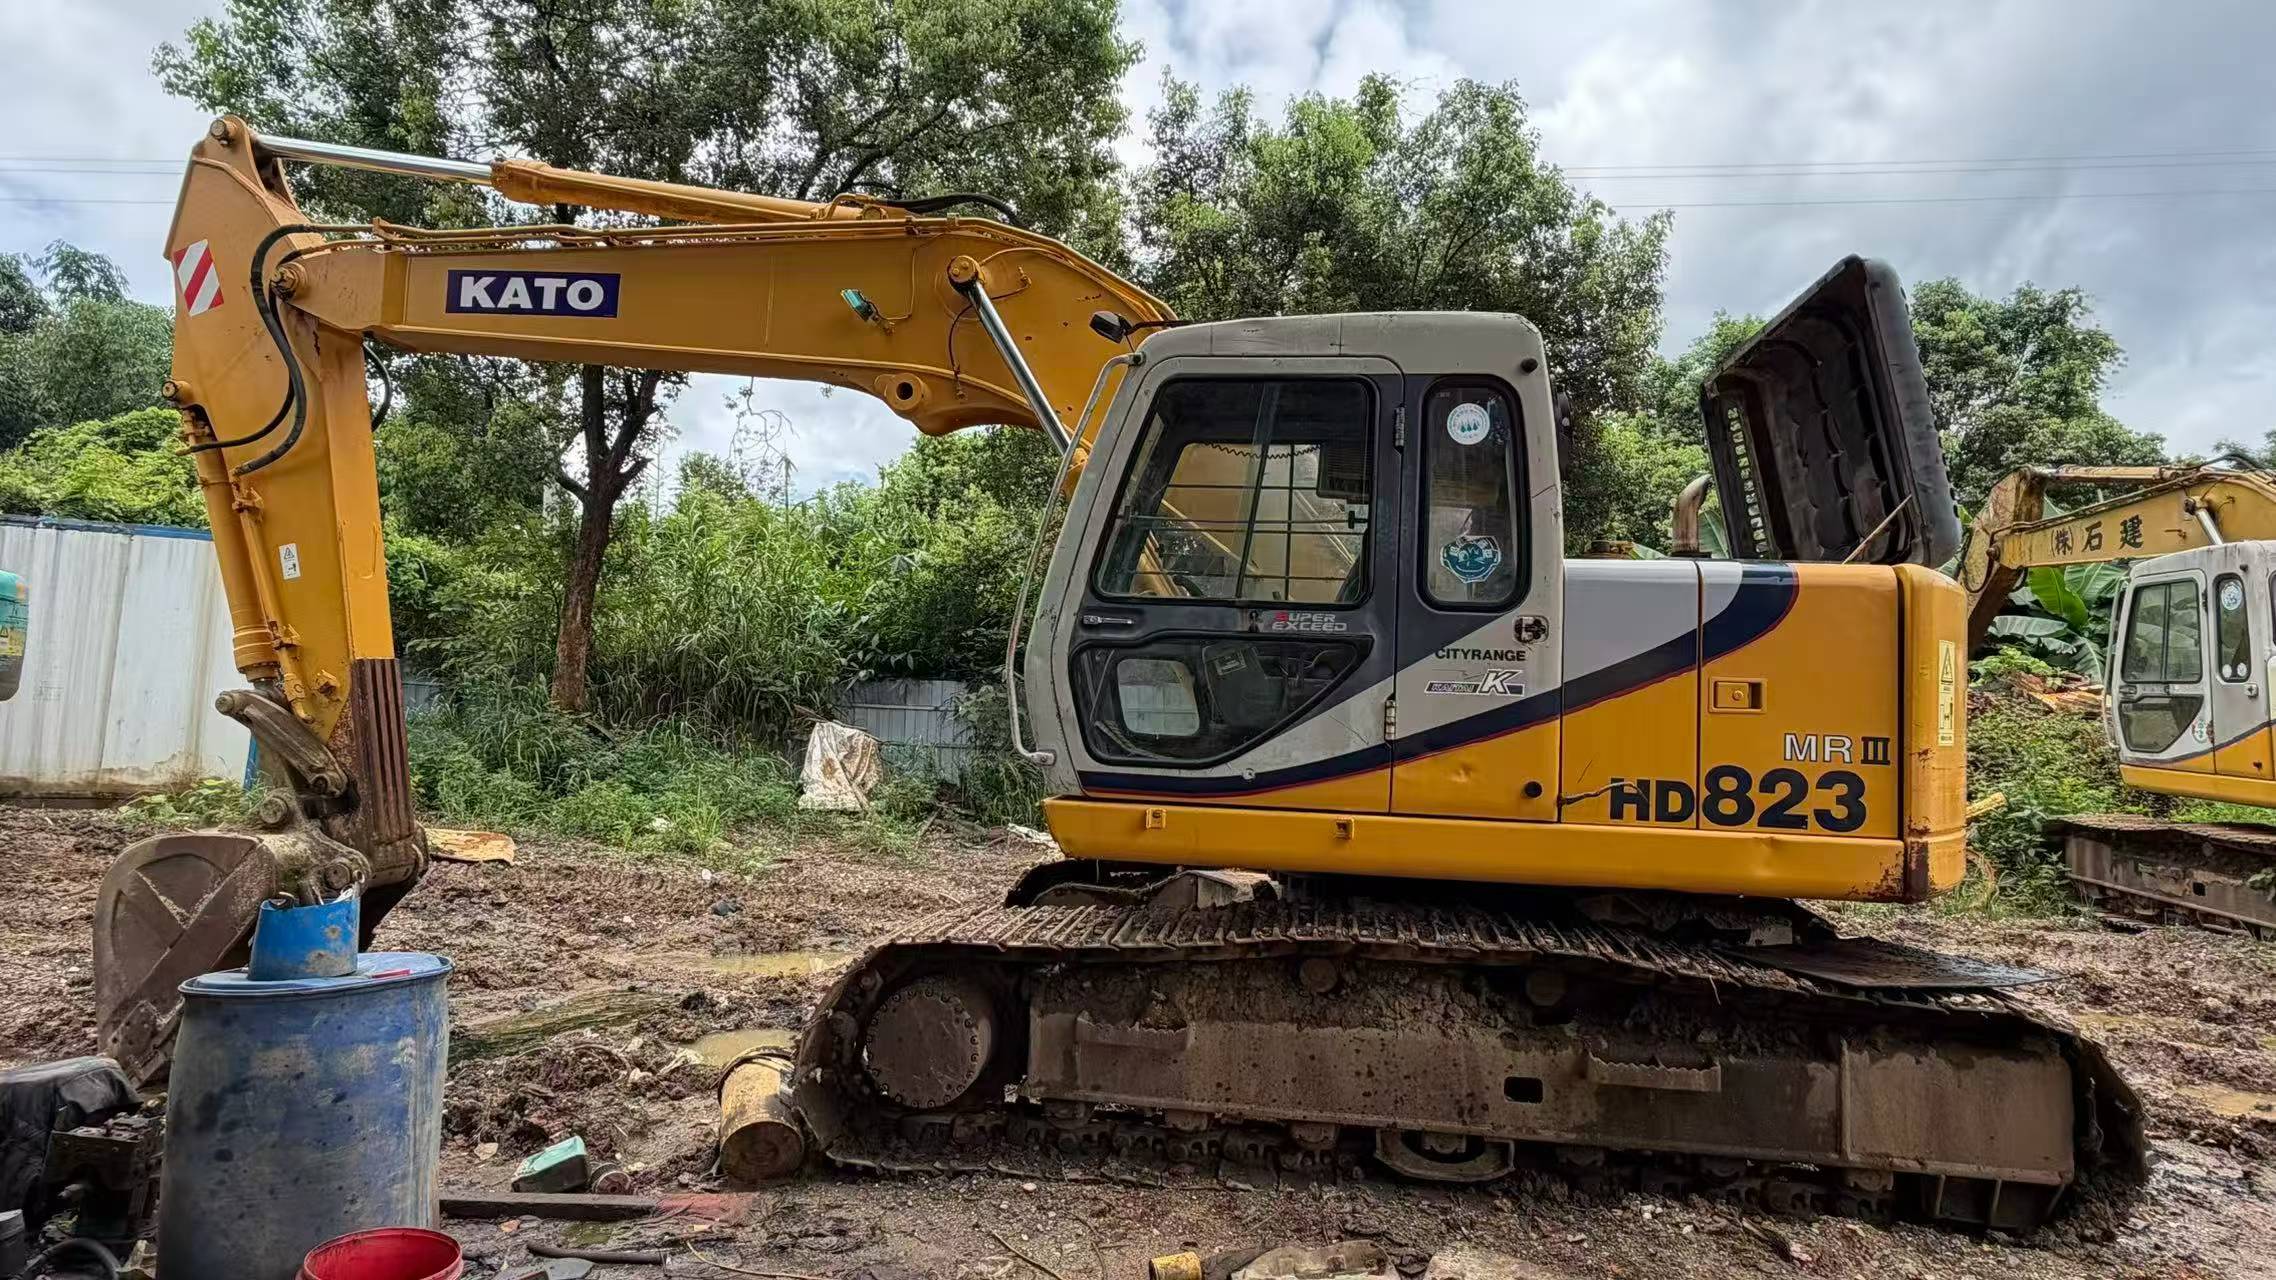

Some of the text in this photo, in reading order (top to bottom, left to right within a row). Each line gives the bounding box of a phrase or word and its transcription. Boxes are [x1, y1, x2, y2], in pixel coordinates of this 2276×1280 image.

[460, 276, 604, 310] KATO
[1274, 611, 1336, 622] SUPER
[1271, 621, 1348, 631] EXCEED
[1434, 648, 1526, 661] CITYRANGE
